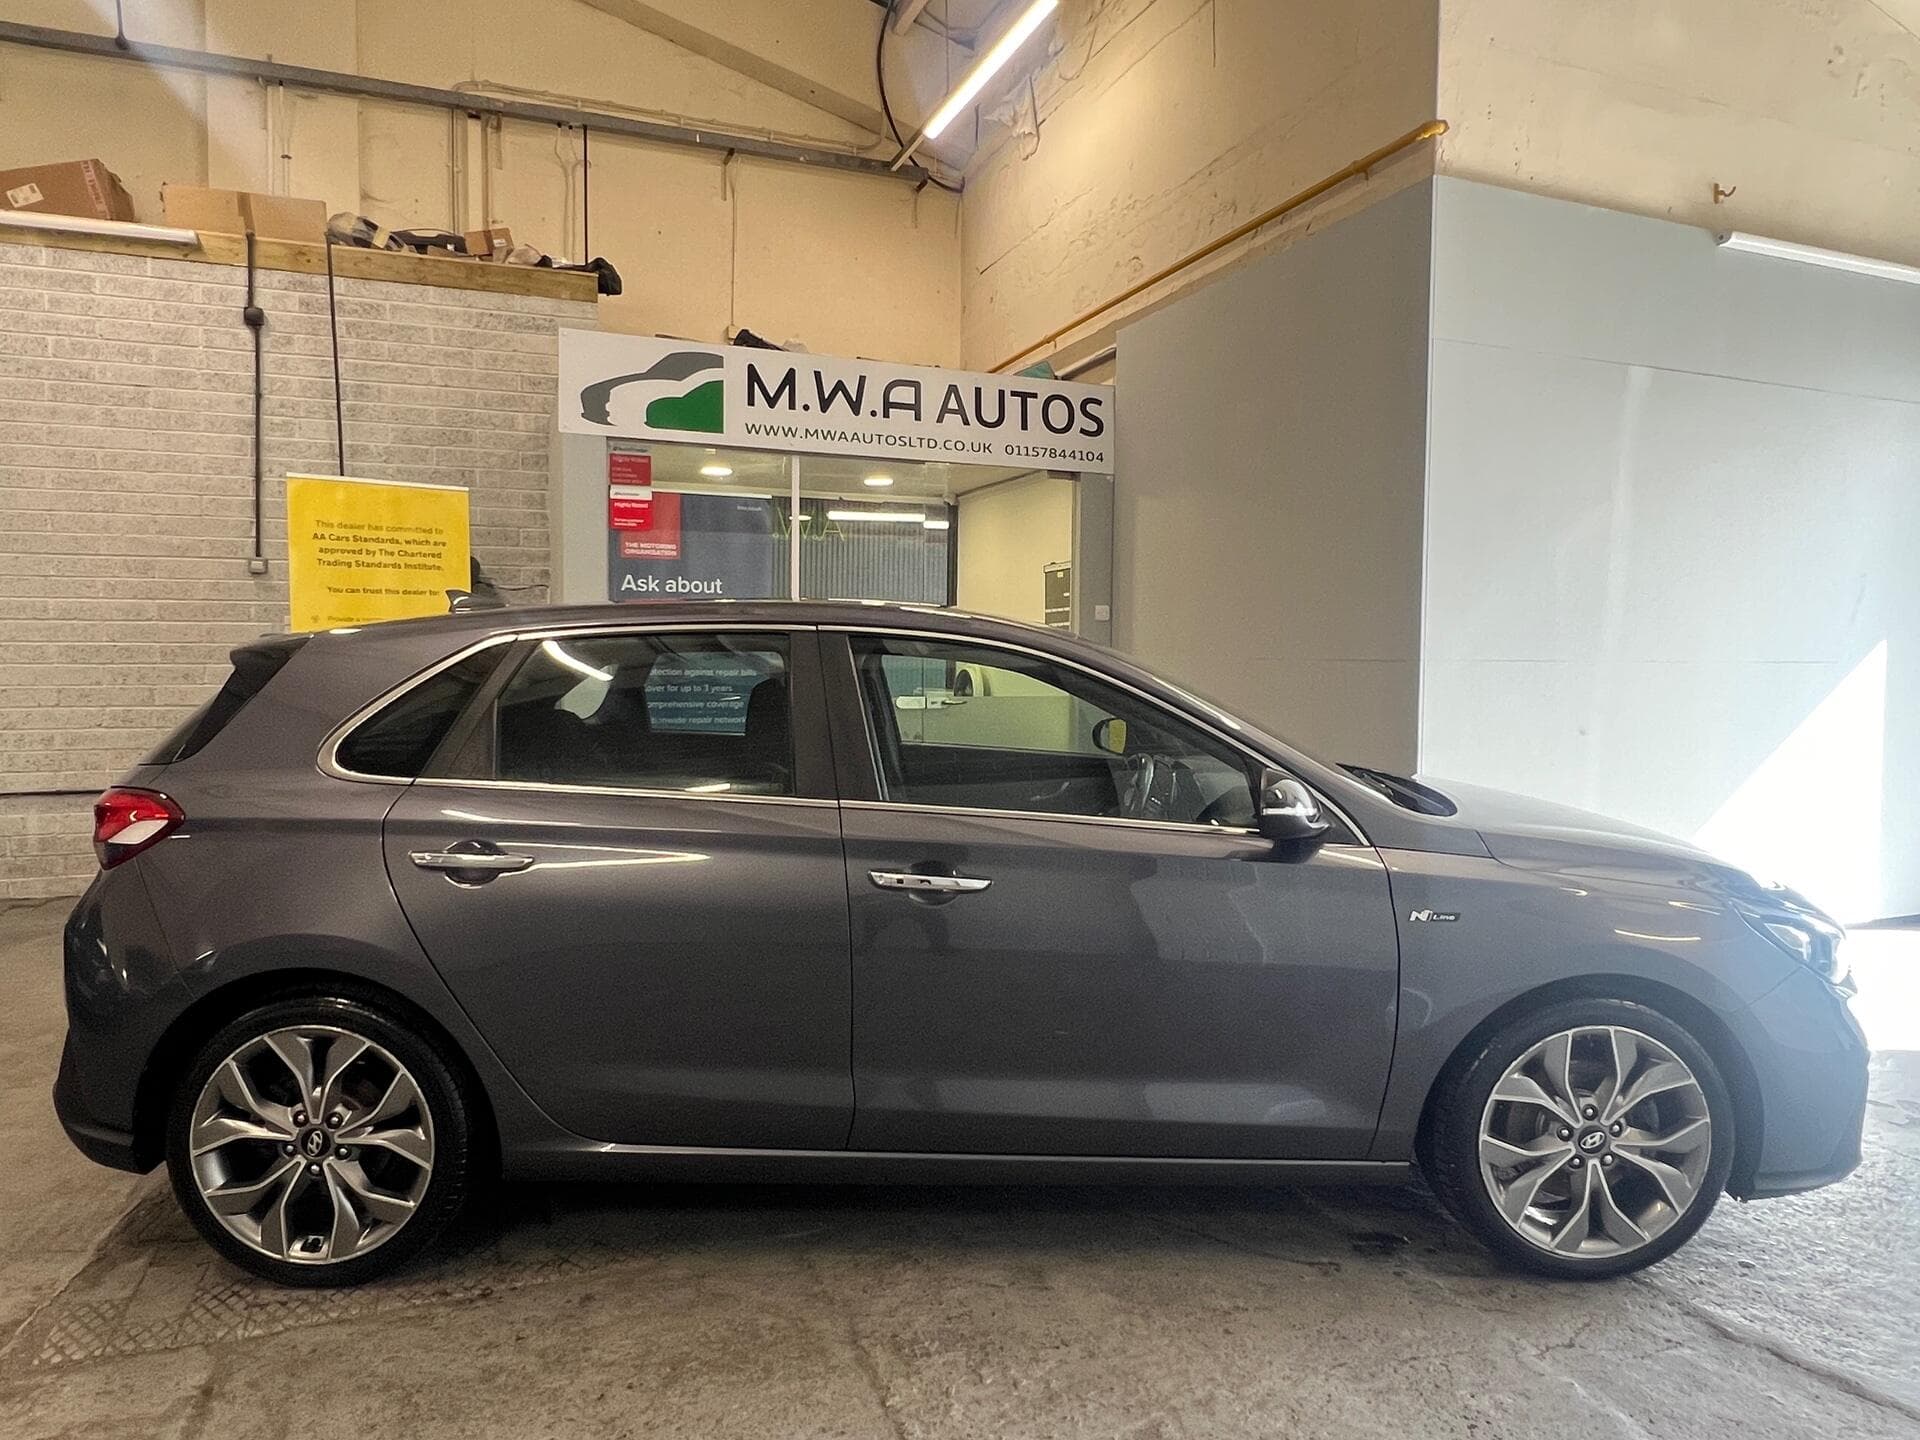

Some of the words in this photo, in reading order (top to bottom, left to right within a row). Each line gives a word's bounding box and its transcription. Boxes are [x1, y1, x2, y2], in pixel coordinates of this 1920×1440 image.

[746, 362, 922, 422] M.W.A
[935, 384, 1105, 438] AUTOS
[744, 421, 993, 455] WWW.MWAAUTOSLTD.CO.UK
[1004, 443, 1104, 464] 01157844104
[315, 519, 334, 529] This
[336, 521, 366, 531] dealer
[367, 523, 384, 532] has
[385, 525, 433, 535] committed
[434, 527, 444, 535] to
[312, 532, 326, 541] AA
[328, 533, 351, 542] Cars
[352, 534, 402, 545] Standards,
[404, 538, 431, 547] which
[432, 540, 447, 548] are
[625, 541, 639, 549] THE
[640, 542, 677, 550] MOTORING
[318, 546, 363, 556] approved
[365, 548, 377, 558] by
[378, 548, 395, 557] The
[397, 549, 442, 560] Chartered
[316, 558, 353, 569] Trading
[354, 559, 402, 570] Standards
[403, 562, 445, 571] Institute.
[620, 574, 660, 593] Ask
[665, 575, 723, 594] about
[327, 586, 343, 594] You
[362, 587, 382, 595] trust
[384, 588, 399, 596] this
[401, 588, 428, 597] dealer
[684, 668, 714, 678] against
[715, 668, 740, 678] repair
[666, 683, 679, 692] for
[681, 685, 692, 693] up
[693, 684, 702, 692] to
[706, 701, 745, 710] coverage
[688, 716, 713, 725] repair
